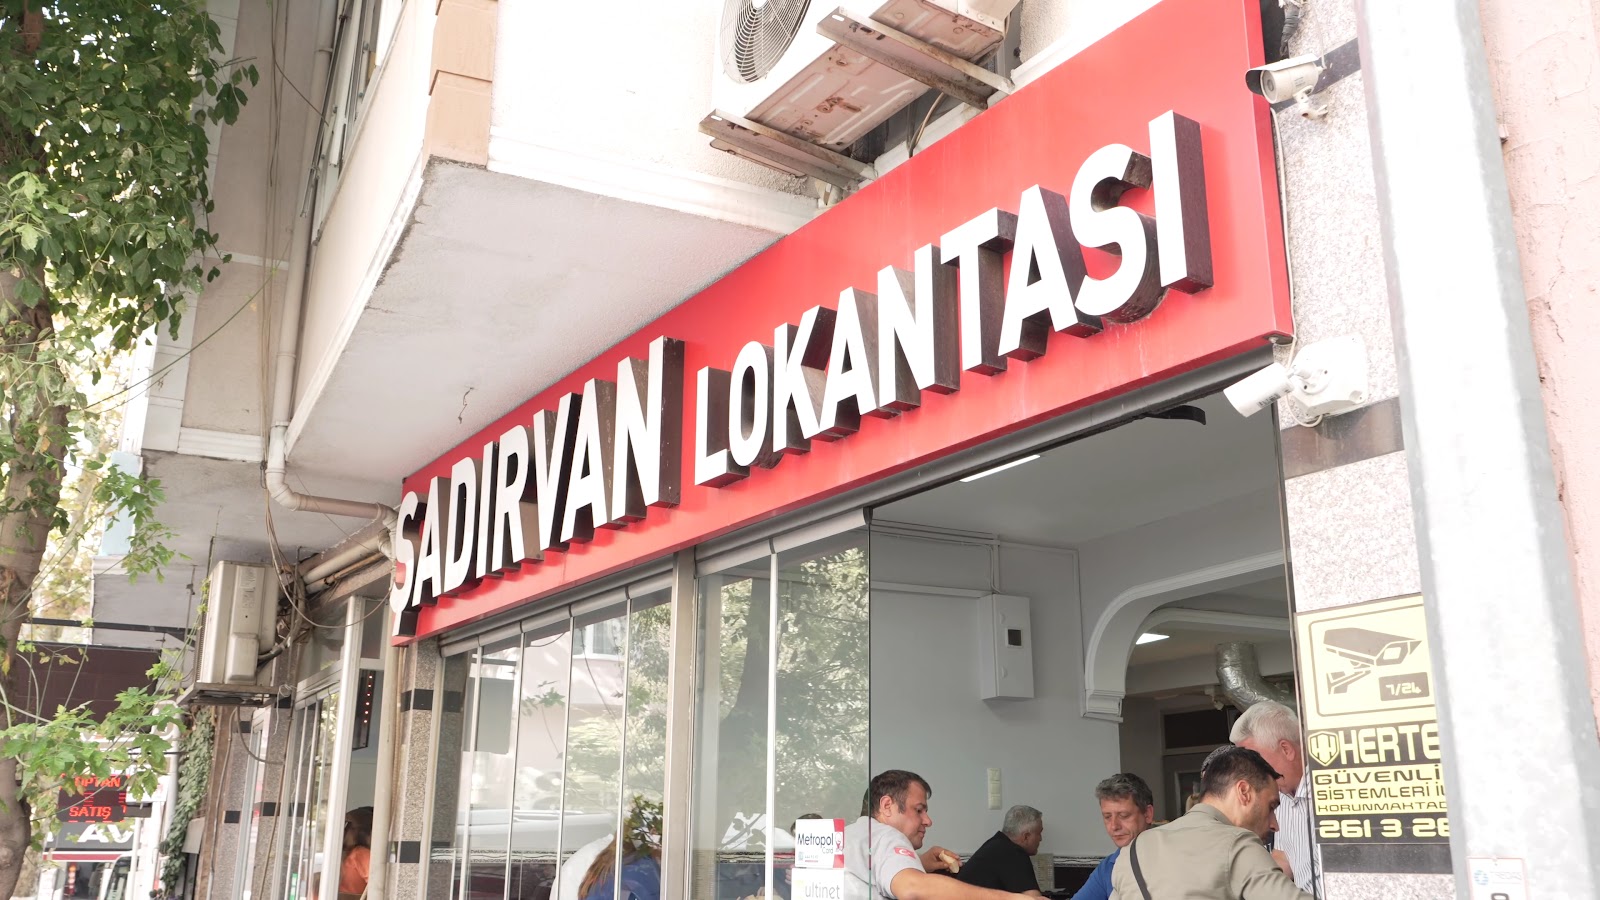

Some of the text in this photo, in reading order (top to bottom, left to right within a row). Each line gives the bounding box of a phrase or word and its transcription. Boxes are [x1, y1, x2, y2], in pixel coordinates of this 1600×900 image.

[694, 110, 1208, 487] LOKANTASI
[1385, 682, 1422, 696] 7/24
[1317, 781, 1430, 801] SİSTEMLERİ
[69, 806, 112, 820] SATIŞ
[1319, 819, 1371, 838] 261
[1380, 818, 1403, 838] 3
[797, 833, 834, 848] Metropol
